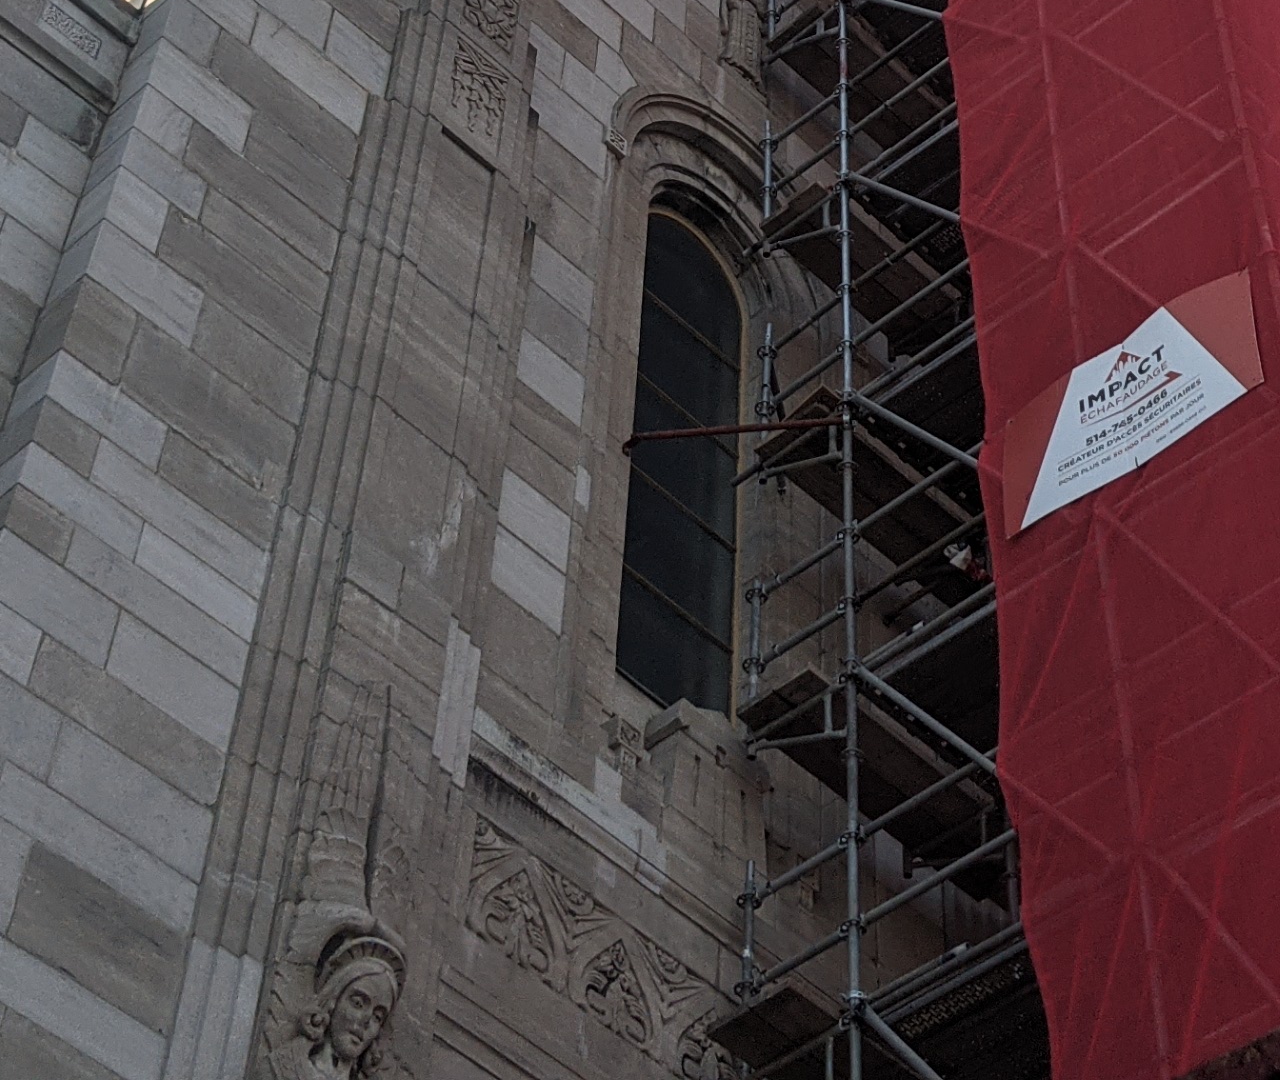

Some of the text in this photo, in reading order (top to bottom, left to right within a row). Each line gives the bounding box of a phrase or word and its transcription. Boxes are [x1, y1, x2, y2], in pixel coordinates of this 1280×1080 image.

[1079, 344, 1165, 413] IMPACT
[1080, 360, 1168, 424] ÉCHAFAUDAGE
[1057, 443, 1105, 472] CRÉATEUR
[1144, 378, 1202, 425] SÉCURITAIRES
[1080, 461, 1100, 475] PLUS
[1101, 454, 1112, 465] DE
[1170, 407, 1185, 421] PAR
